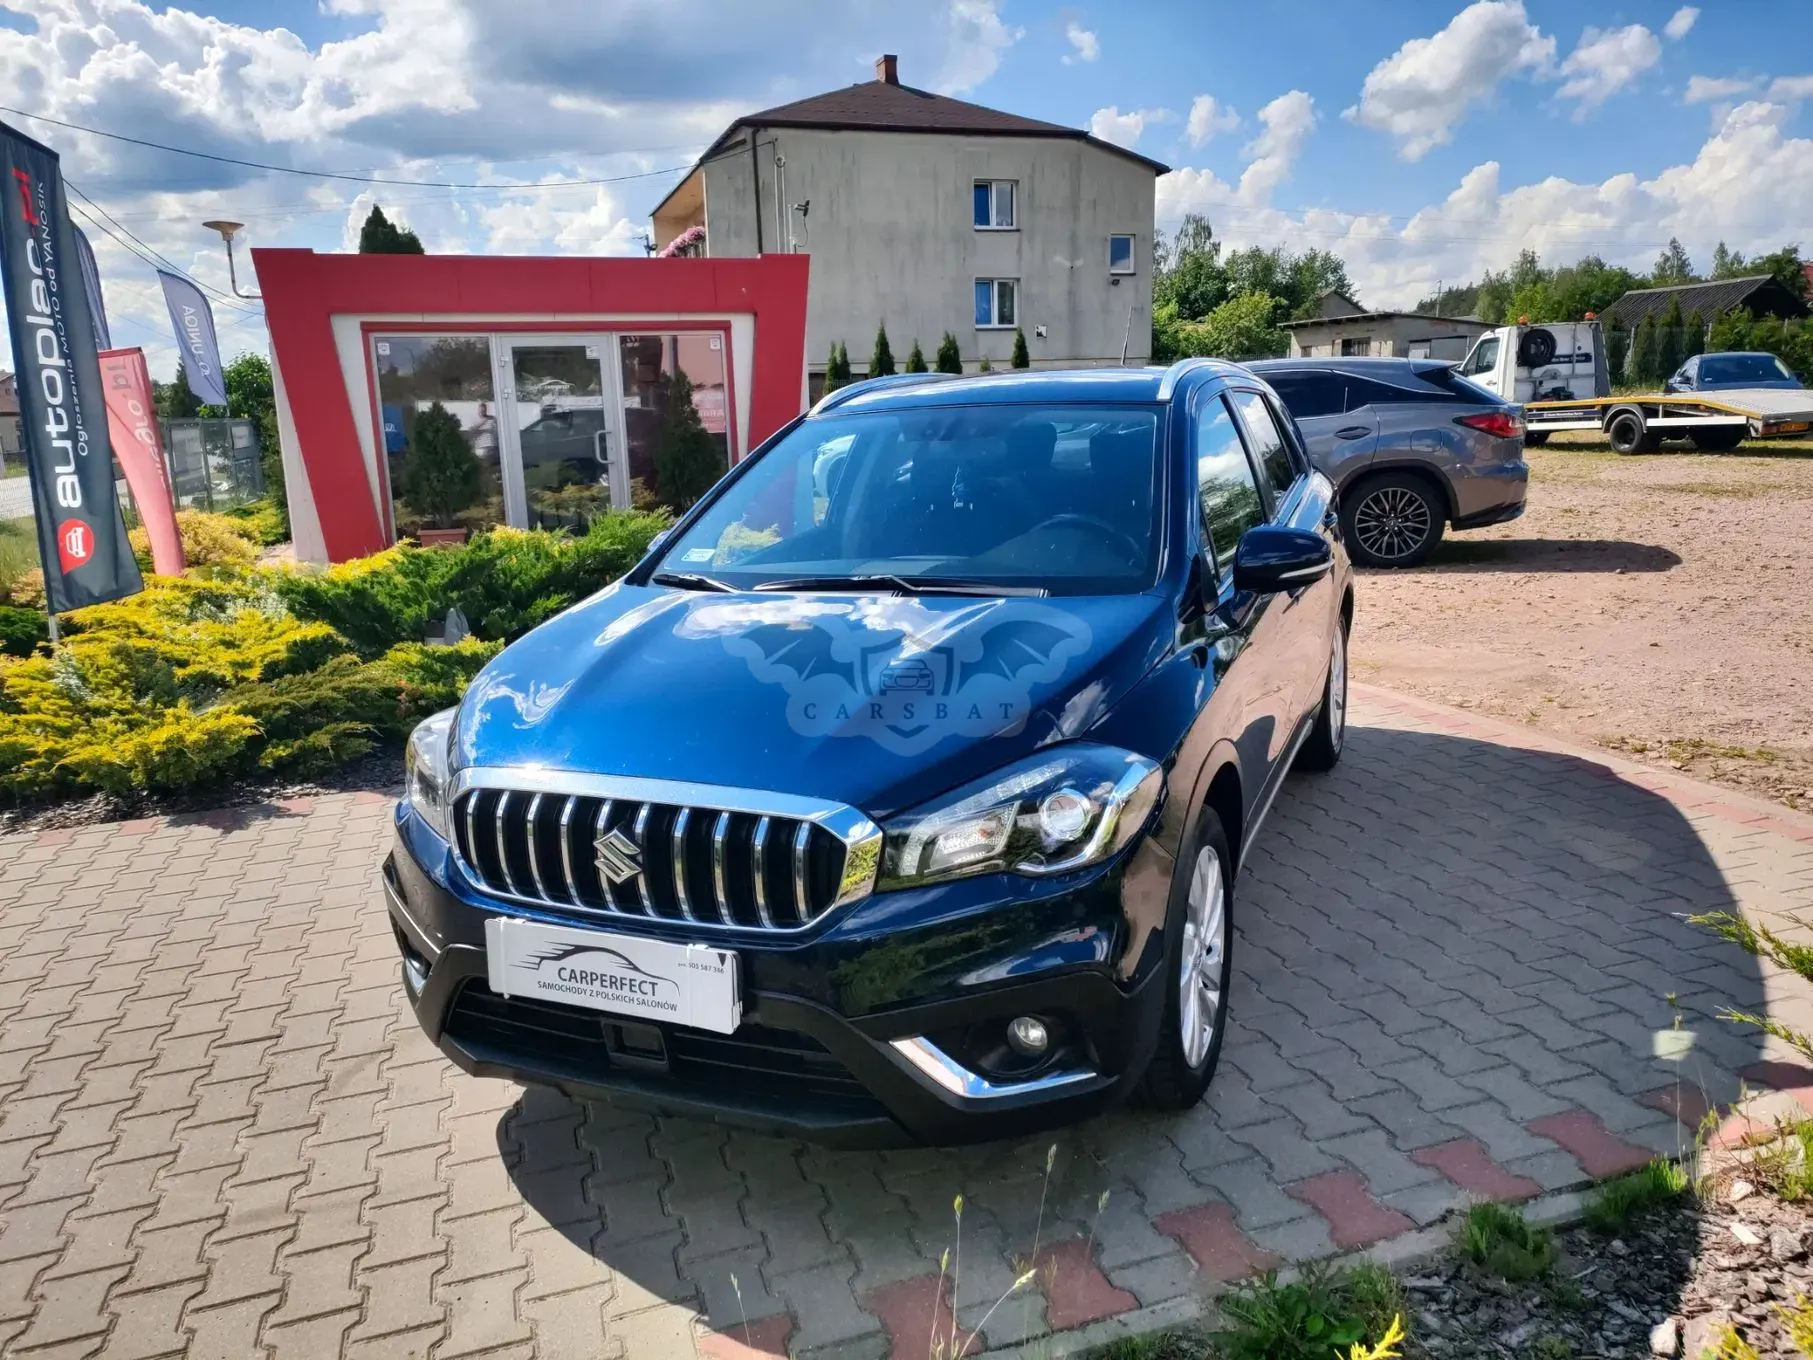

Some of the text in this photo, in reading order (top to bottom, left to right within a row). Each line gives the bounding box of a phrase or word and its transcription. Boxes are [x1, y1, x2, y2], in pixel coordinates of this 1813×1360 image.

[37, 181, 54, 263] YANOSIK
[45, 267, 57, 292] od
[51, 296, 69, 353] MOTO
[537, 980, 678, 1012] SAMOCHODY Z POLSKICH SALONÓW
[557, 966, 659, 997] CARPERFECT
